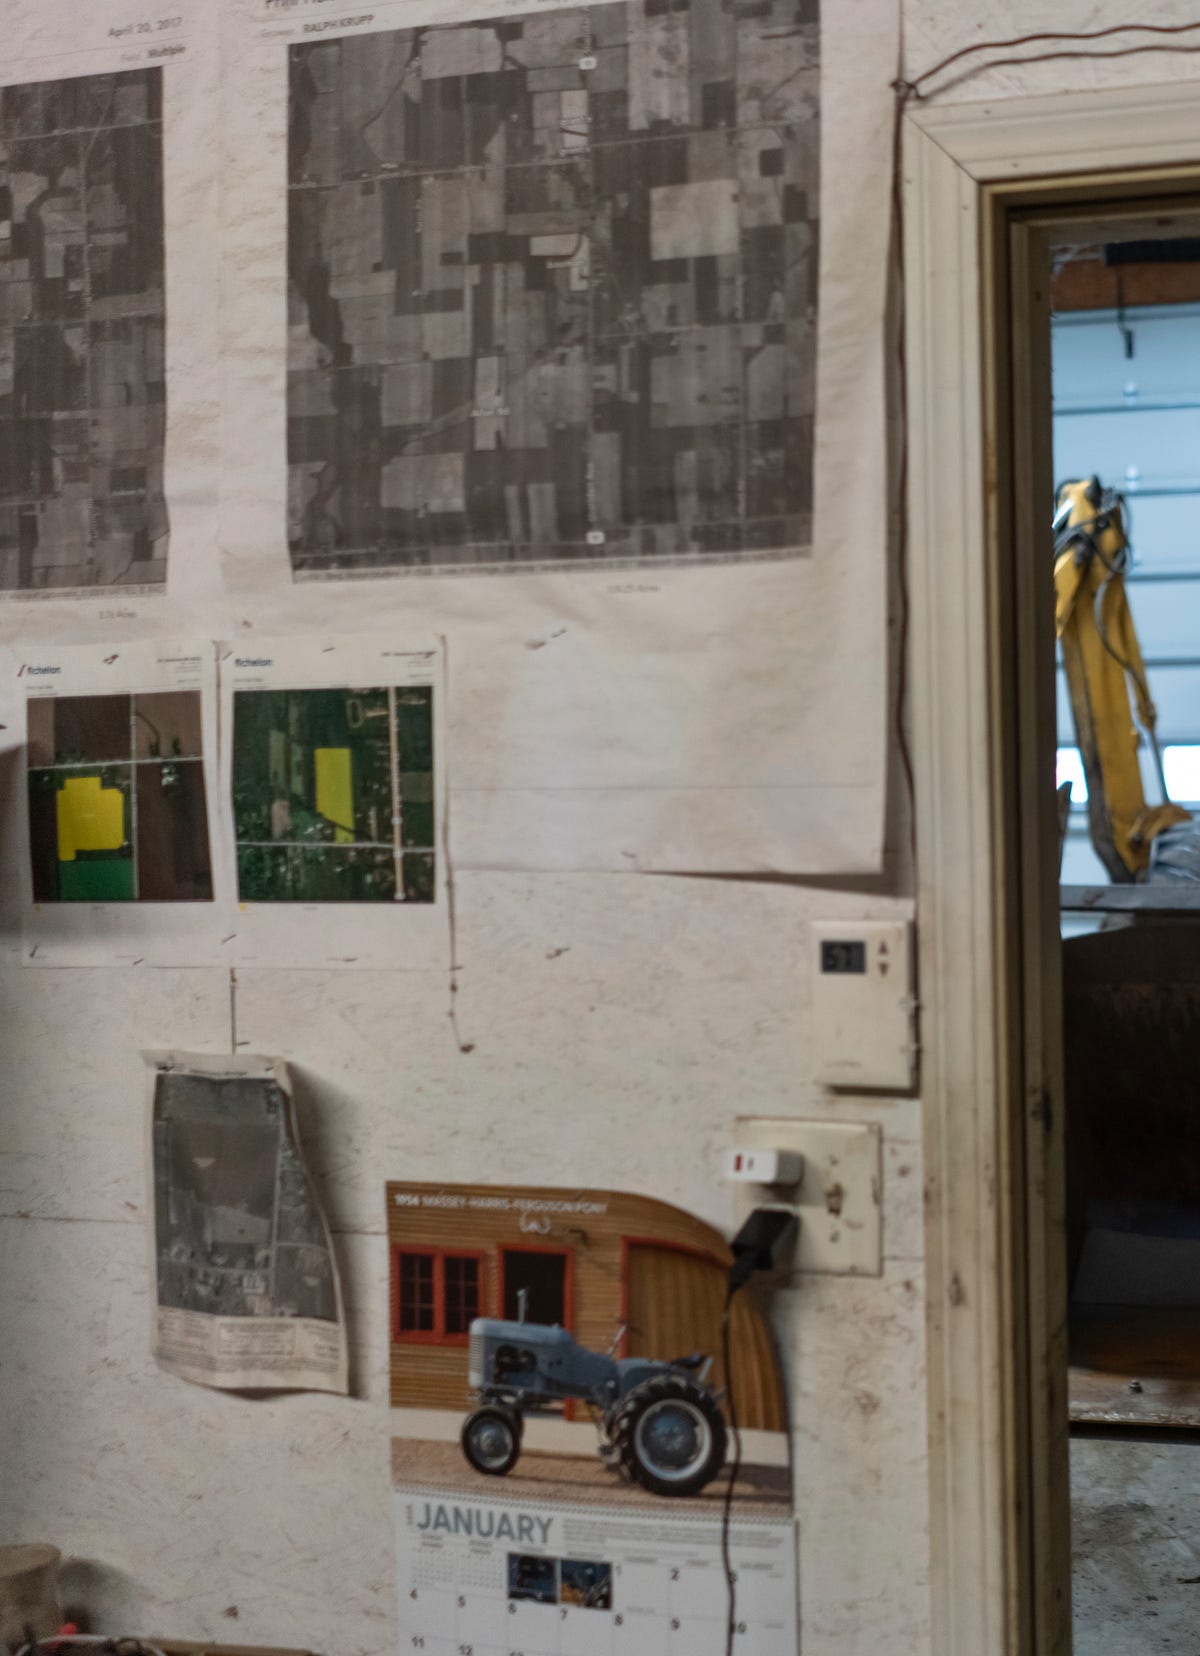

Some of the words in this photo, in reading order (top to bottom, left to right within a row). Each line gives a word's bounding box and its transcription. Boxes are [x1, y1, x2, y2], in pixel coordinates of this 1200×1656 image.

[303, 20, 337, 33] RALPH
[416, 1503, 553, 1544] JANUARY
[671, 1567, 680, 1581] 2
[410, 1587, 418, 1600] 4
[457, 1595, 466, 1608] 5
[507, 1602, 517, 1615] 6
[560, 1607, 568, 1620] 7
[614, 1612, 623, 1627] 8
[671, 1617, 680, 1631] 9
[411, 1635, 425, 1648] 11
[459, 1644, 473, 1656] 12
